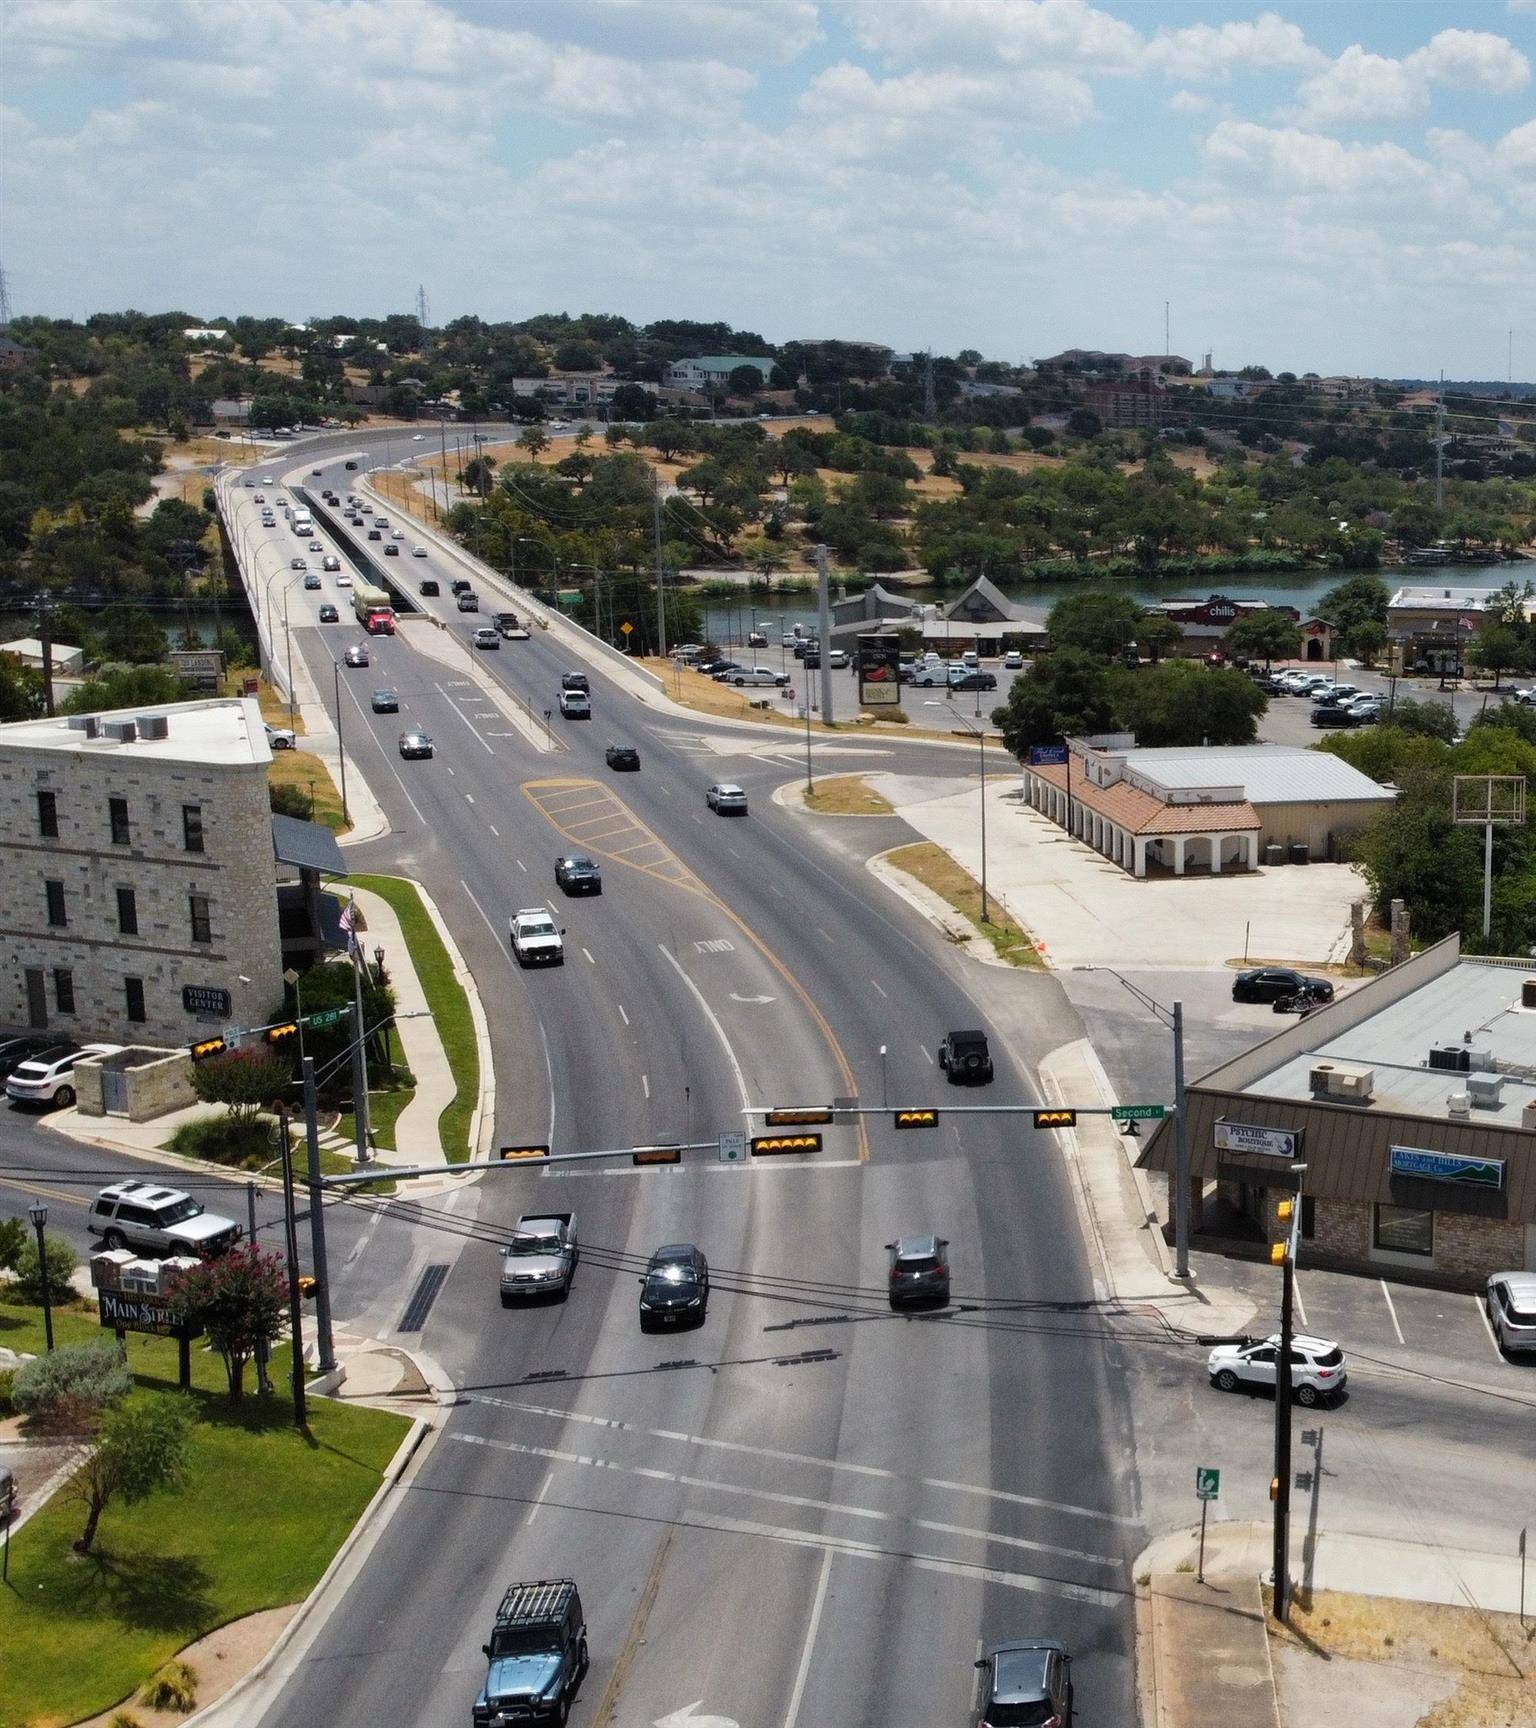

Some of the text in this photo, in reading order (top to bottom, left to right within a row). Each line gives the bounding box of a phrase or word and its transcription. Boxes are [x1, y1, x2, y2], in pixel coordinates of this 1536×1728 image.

[1210, 606, 1236, 617] chilis
[693, 939, 735, 954] ONLY
[187, 988, 224, 1001] VISITOR
[189, 999, 224, 1010] CENTER
[312, 1011, 337, 1025] US 281
[1115, 1107, 1152, 1118] Second
[1230, 1127, 1267, 1139] PSYCHIC
[102, 1296, 138, 1319] MAIN
